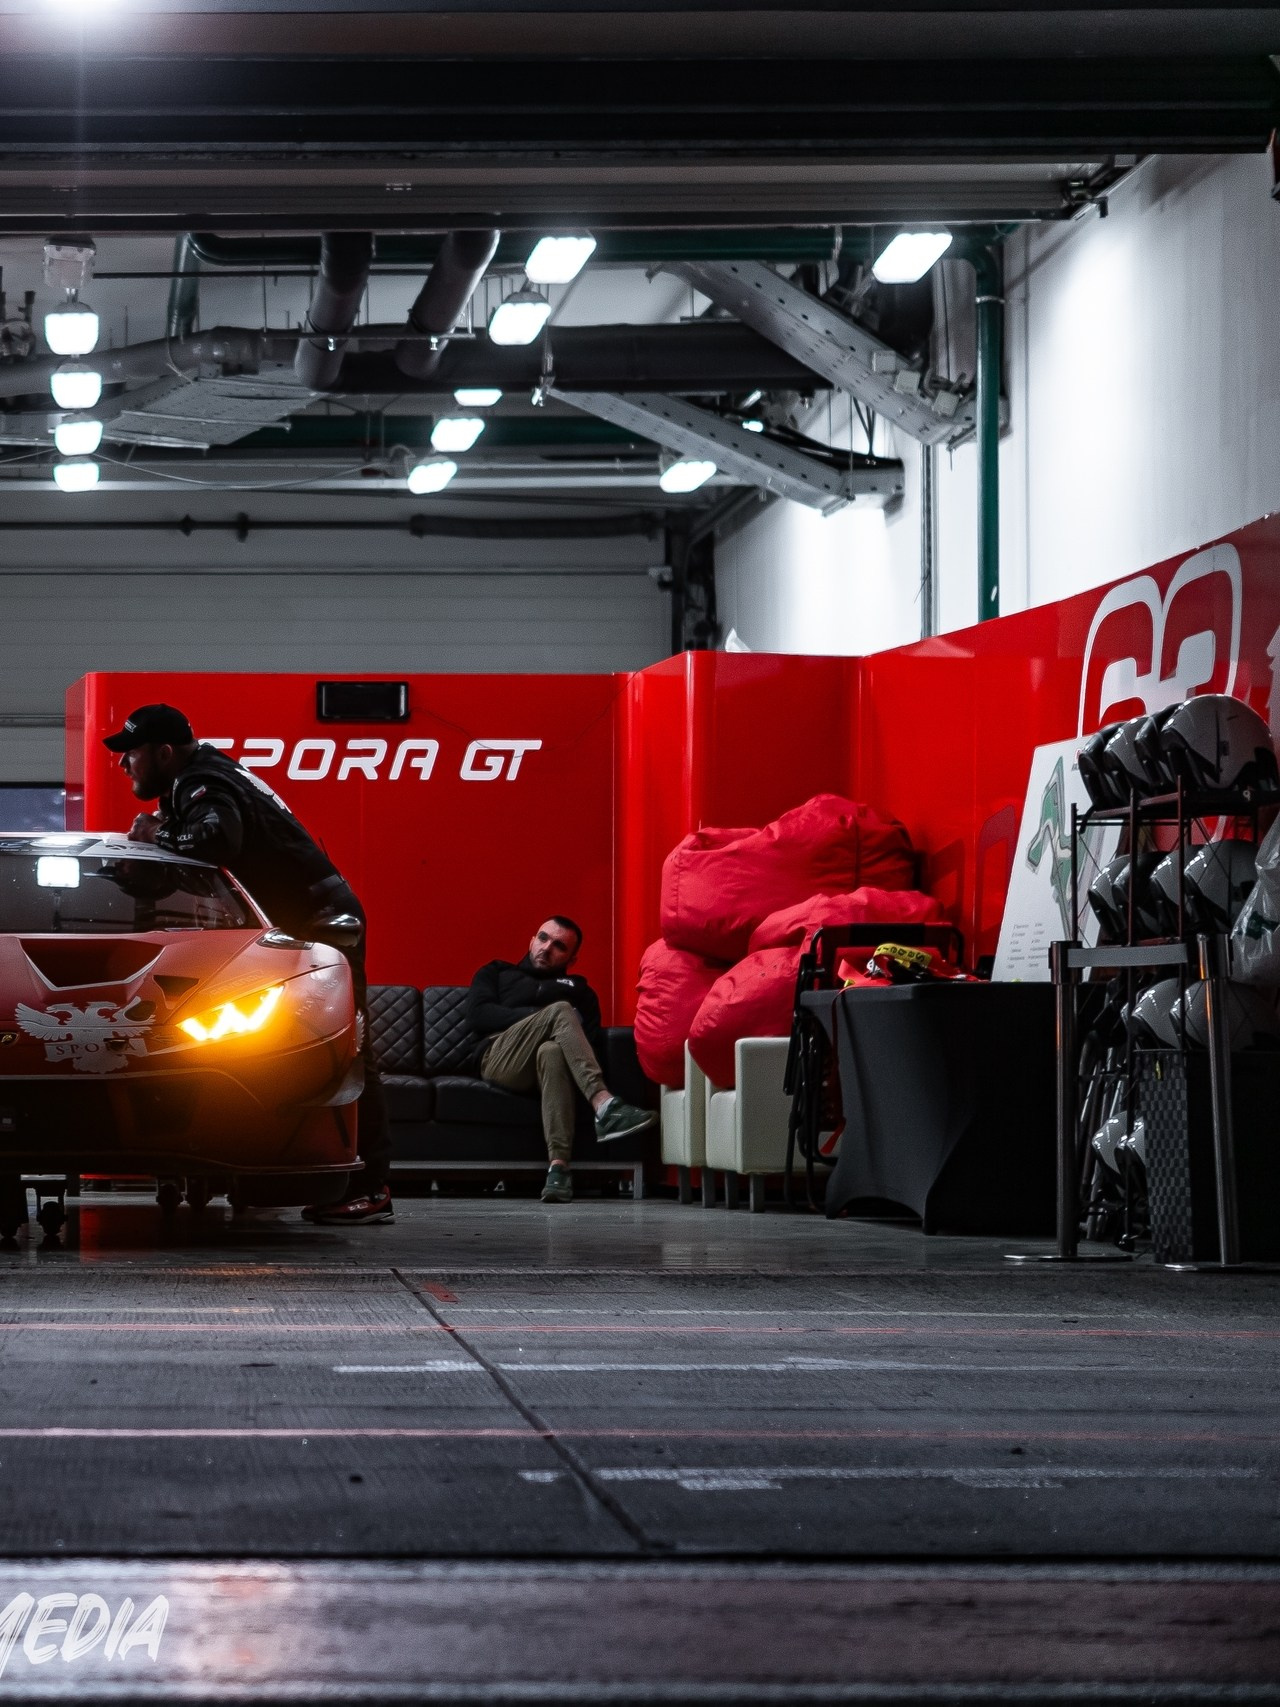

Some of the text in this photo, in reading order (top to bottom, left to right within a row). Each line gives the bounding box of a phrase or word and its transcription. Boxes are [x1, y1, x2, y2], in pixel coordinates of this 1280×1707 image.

[196, 738, 542, 781] PORA GT
[56, 1042, 136, 1056] SPOA
